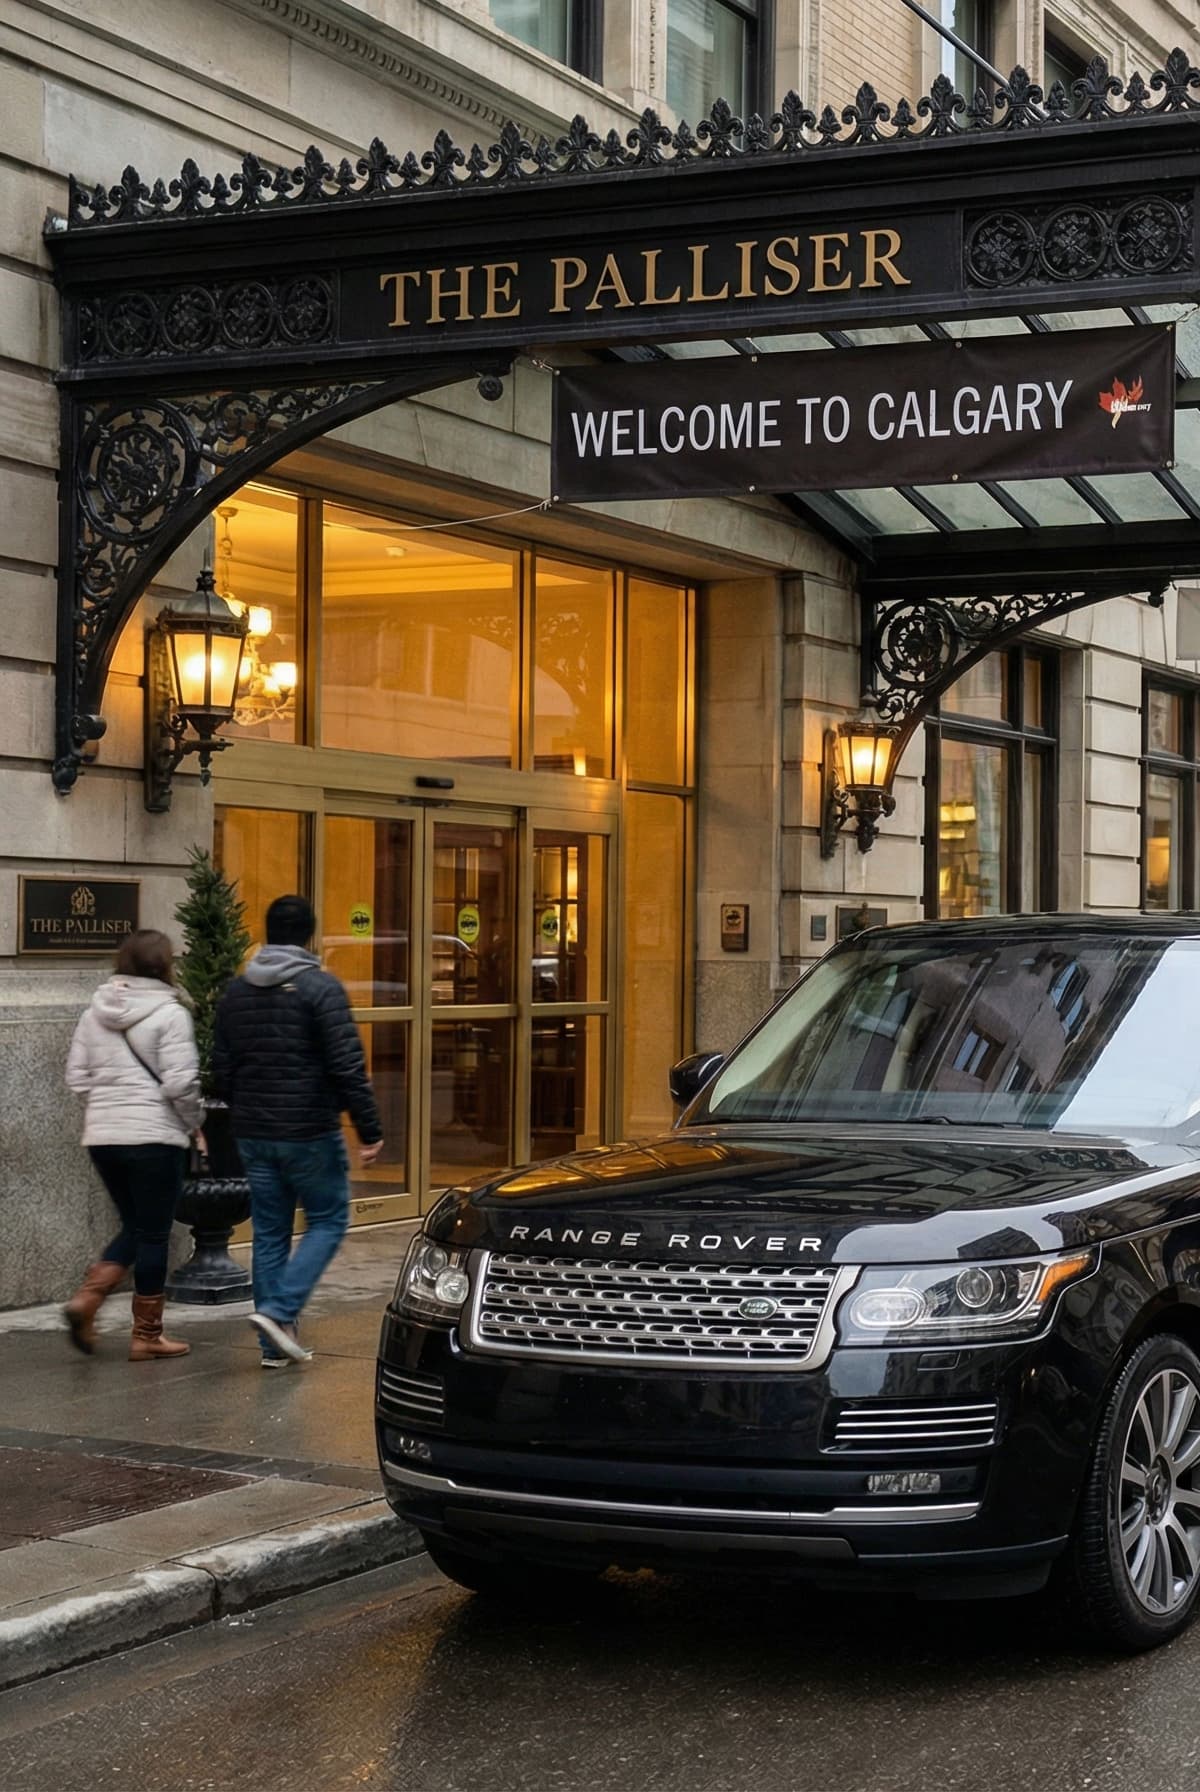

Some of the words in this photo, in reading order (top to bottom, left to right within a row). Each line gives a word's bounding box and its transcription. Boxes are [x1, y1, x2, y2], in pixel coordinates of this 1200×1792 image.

[379, 262, 521, 327] THE
[549, 228, 911, 313] PALLISER
[570, 400, 782, 458] WELCOME
[796, 395, 851, 444] TO
[867, 379, 1074, 440] CALGARY
[31, 918, 62, 933] THE
[65, 919, 133, 935] PALLISER
[509, 1225, 641, 1246] RANGE
[668, 1234, 822, 1251] ROVER
